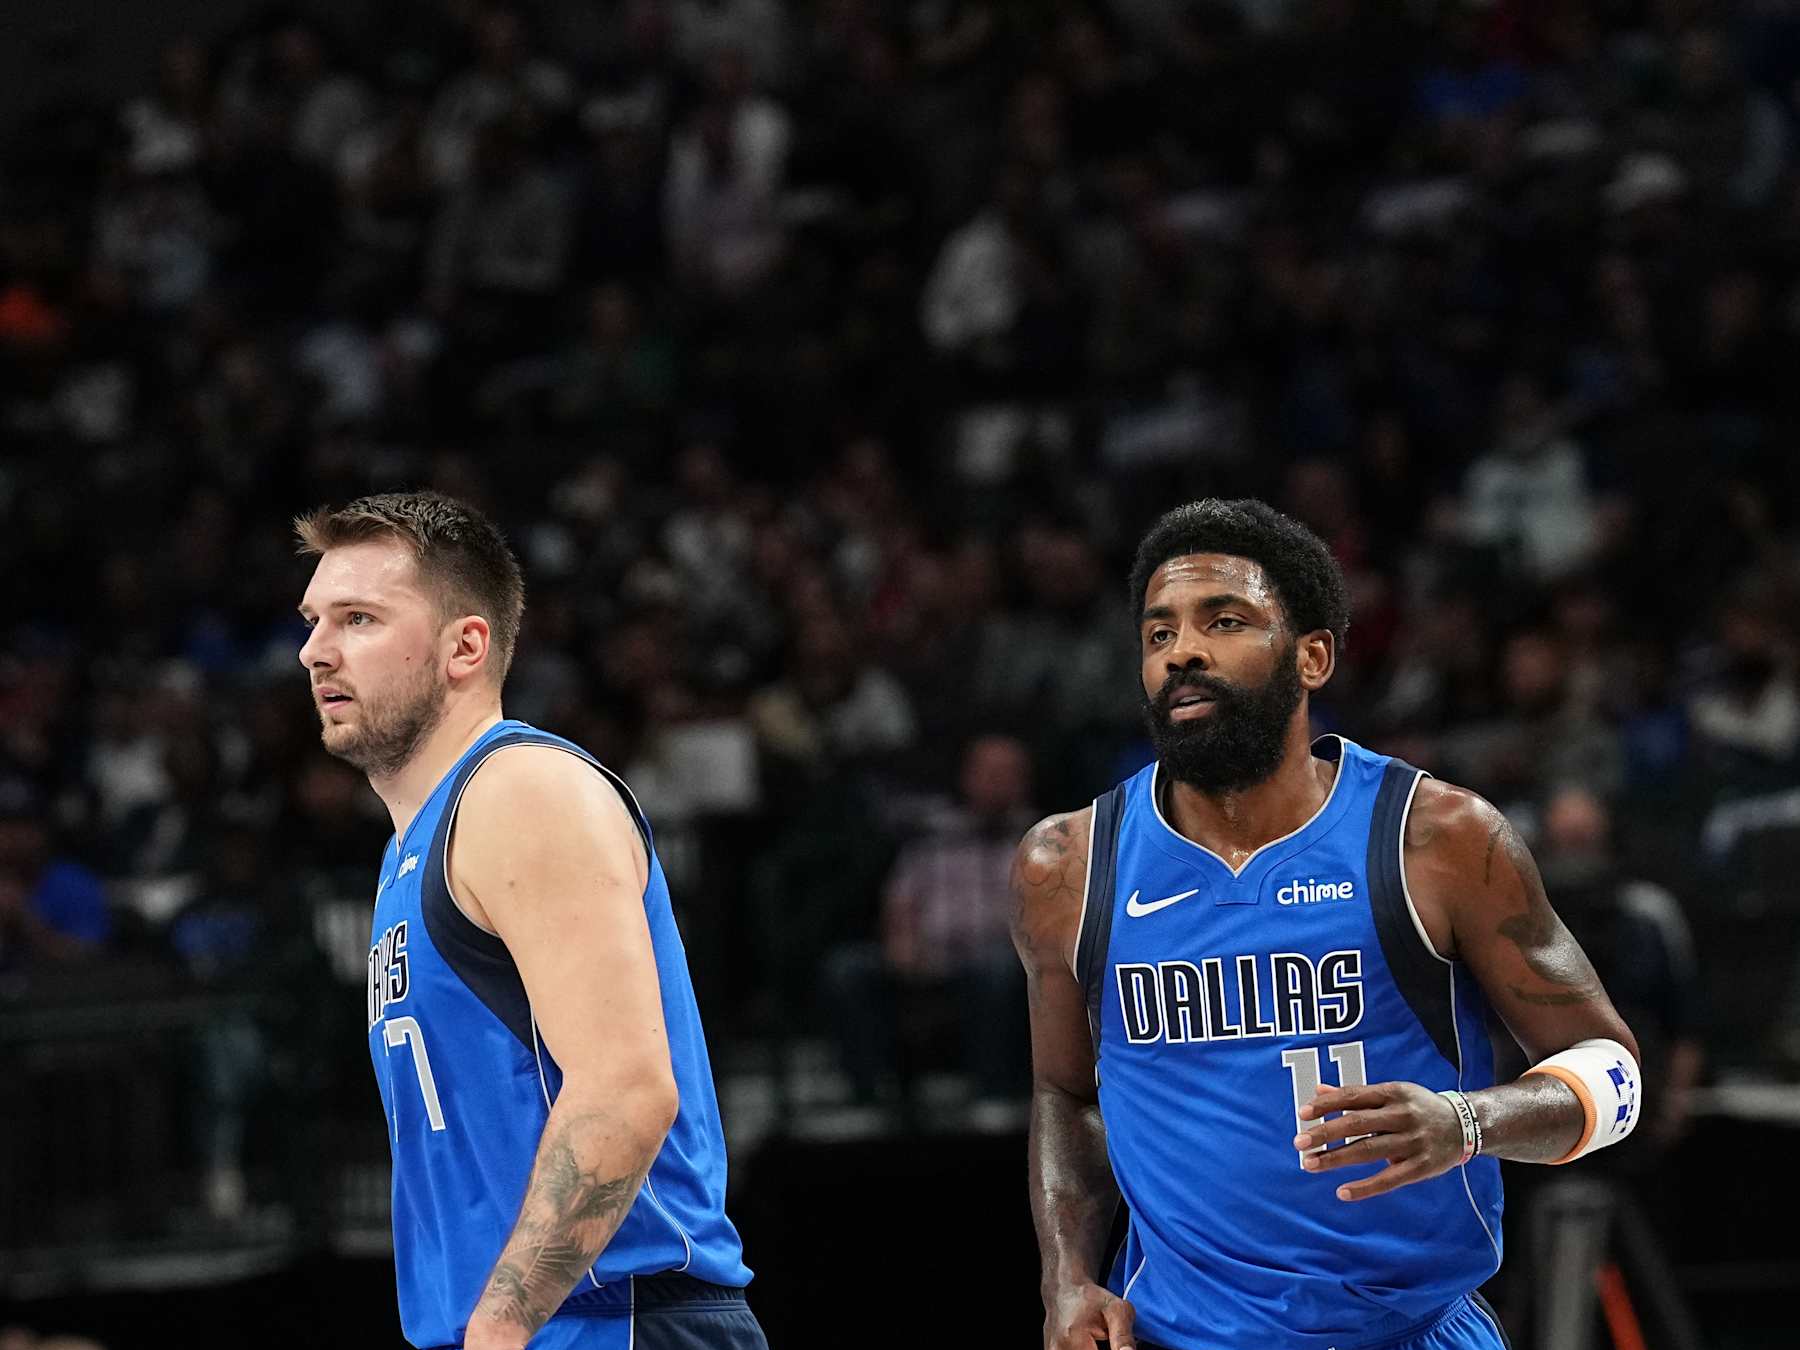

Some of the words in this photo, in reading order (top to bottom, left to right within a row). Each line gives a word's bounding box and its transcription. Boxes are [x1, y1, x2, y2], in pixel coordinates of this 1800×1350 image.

[1277, 879, 1354, 905] chime
[1115, 949, 1365, 1044] DALLAS
[382, 1015, 447, 1143] 7
